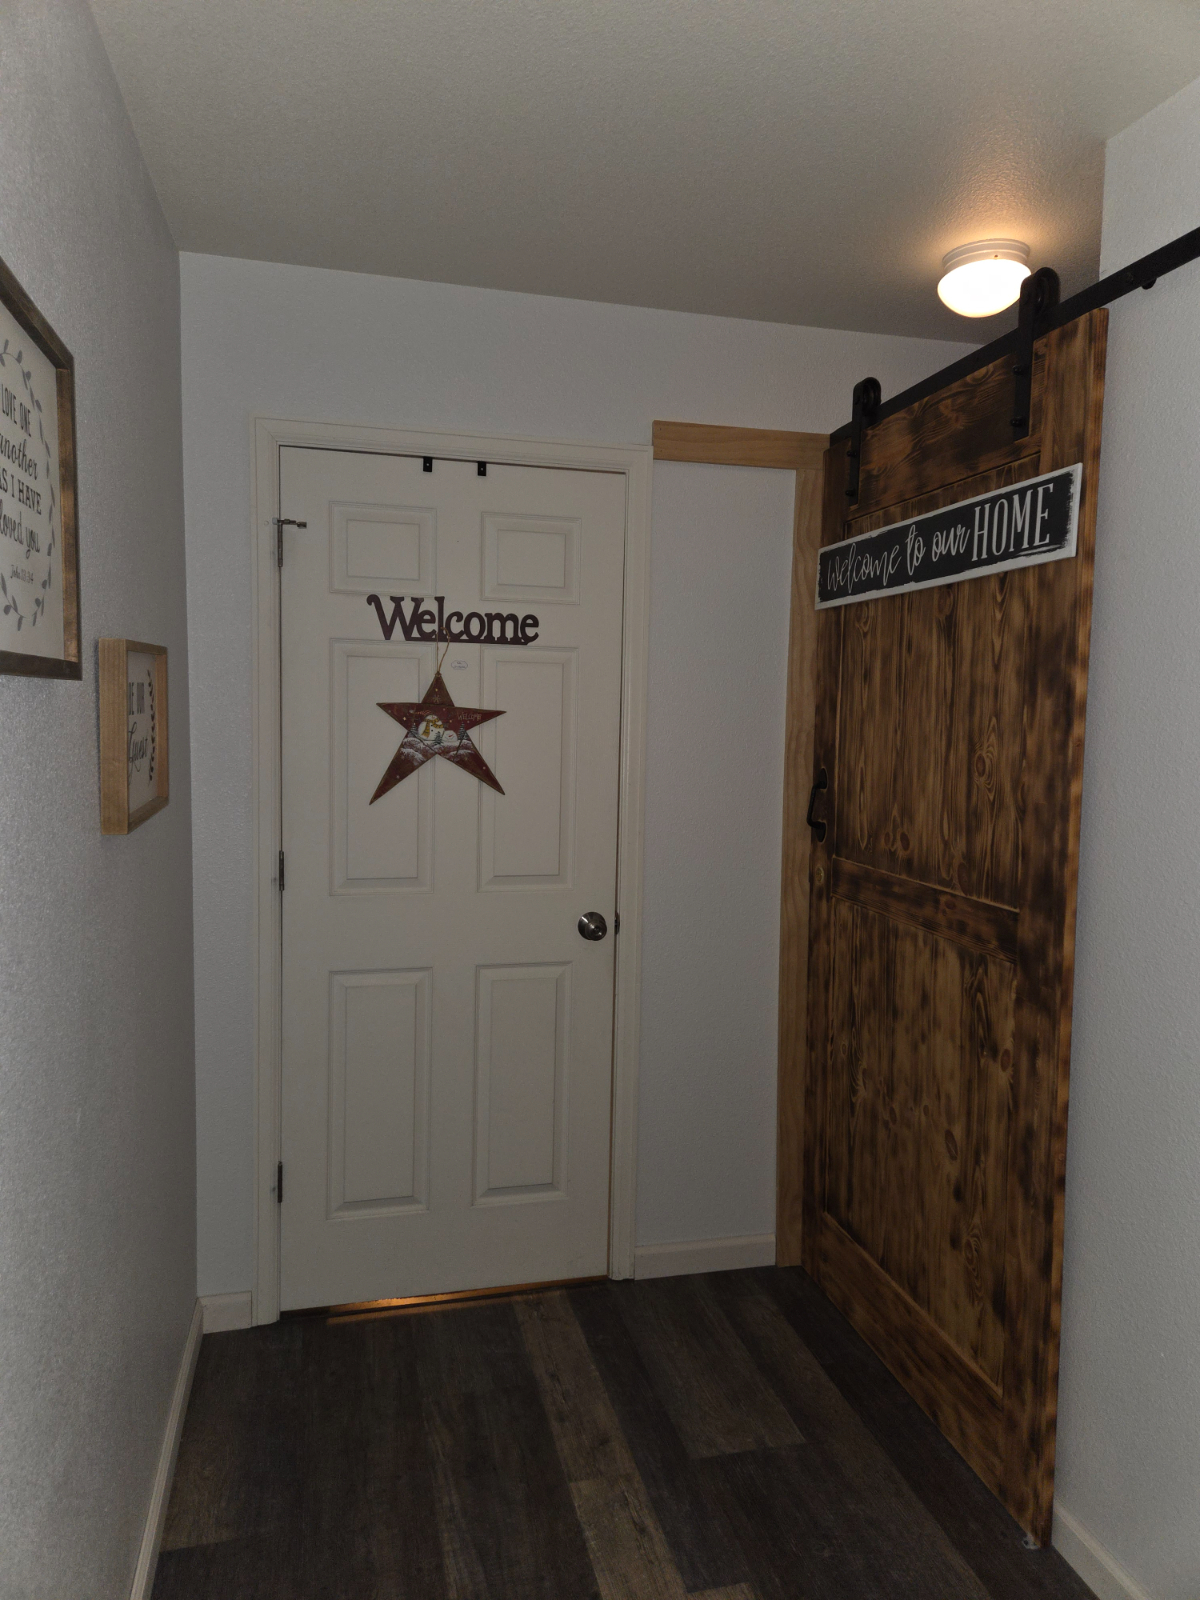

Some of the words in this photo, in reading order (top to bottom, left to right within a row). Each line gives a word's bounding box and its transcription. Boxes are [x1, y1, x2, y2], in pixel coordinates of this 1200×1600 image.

[1, 383, 17, 425] LOVE
[20, 402, 31, 437] ONE
[18, 479, 42, 515] HAVE
[26, 526, 40, 559] you
[906, 524, 926, 576] to
[931, 524, 971, 562] our
[971, 483, 1054, 562] HOME
[366, 594, 539, 646] Welcome
